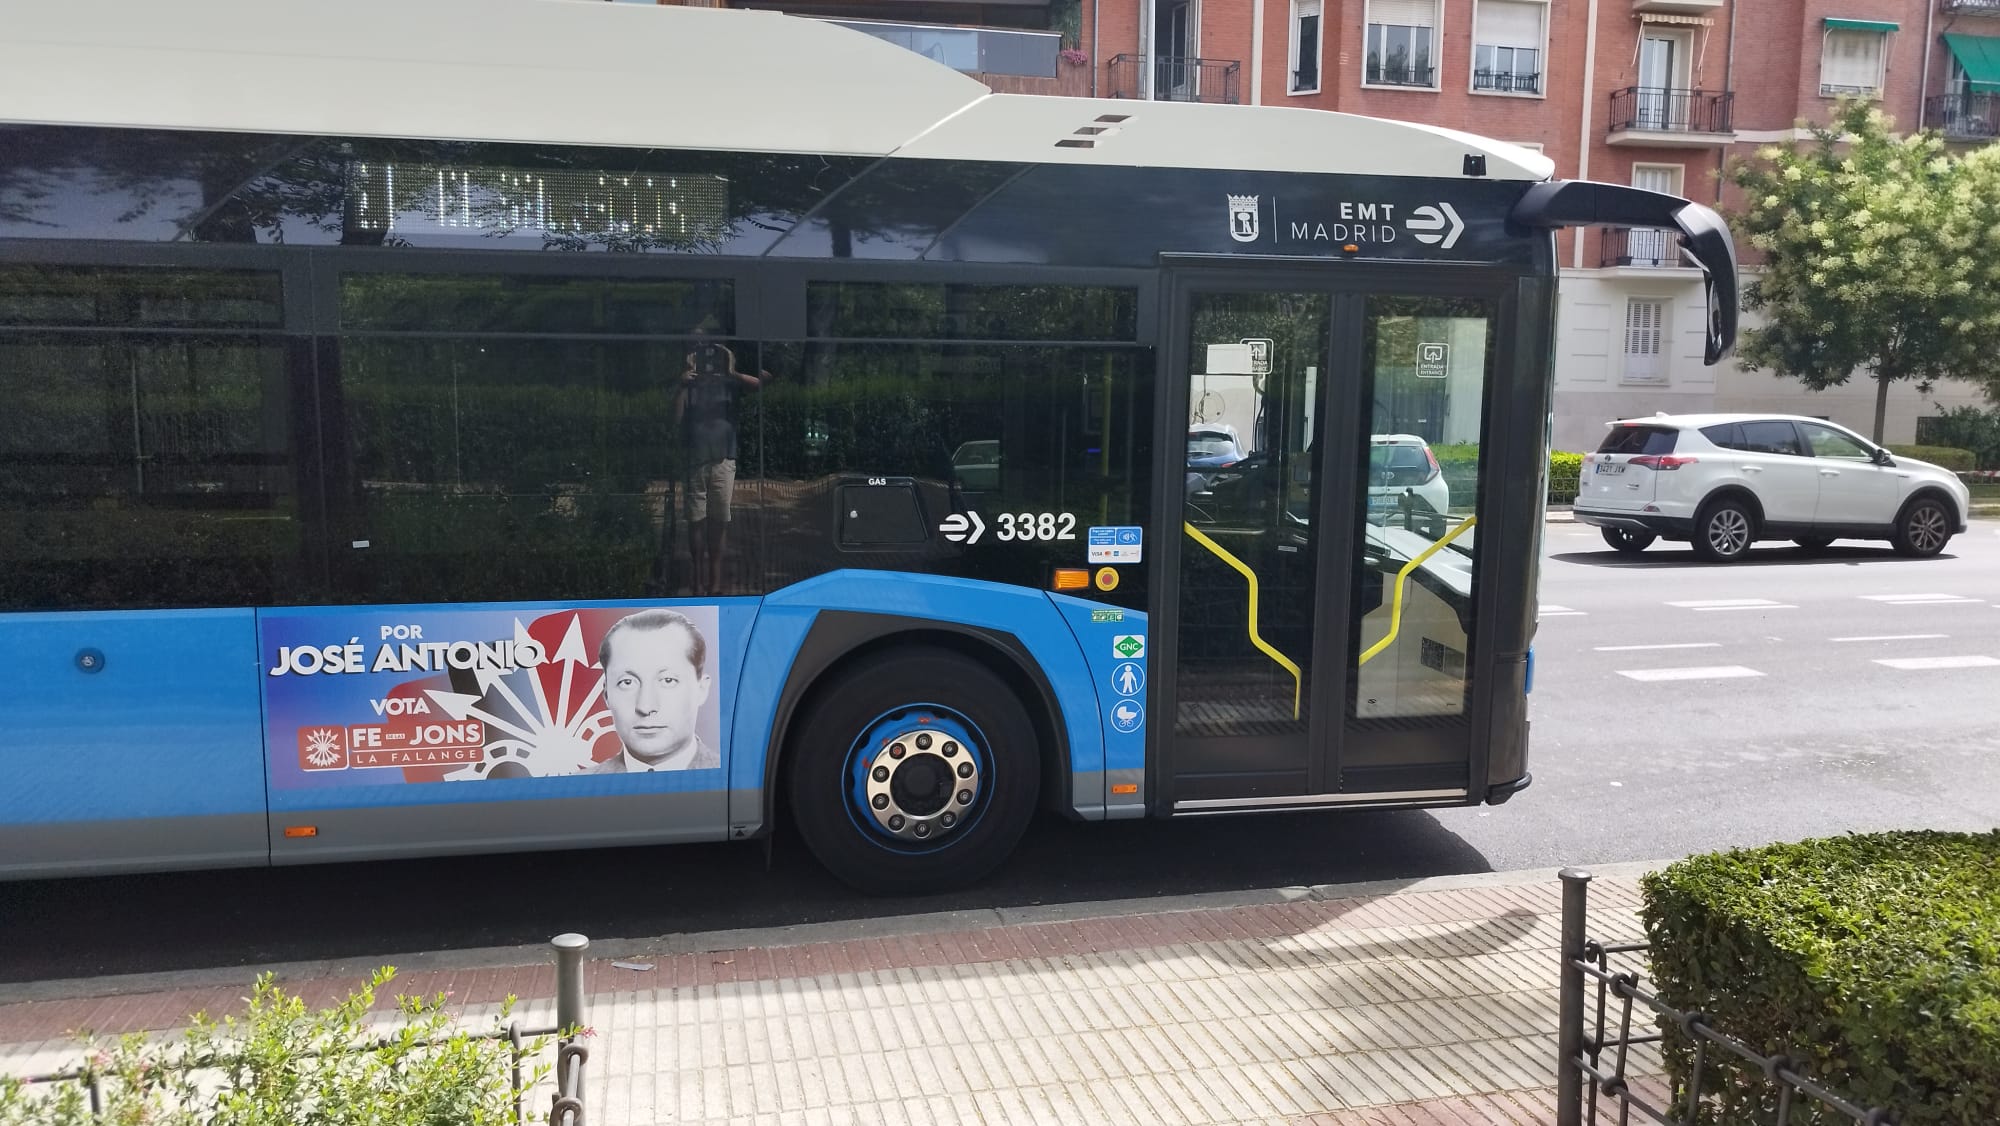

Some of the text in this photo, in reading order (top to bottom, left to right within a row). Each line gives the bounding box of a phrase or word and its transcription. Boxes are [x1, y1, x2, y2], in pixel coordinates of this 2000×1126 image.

[1340, 202, 1395, 221] EMT
[1291, 222, 1396, 243] MADRID
[868, 478, 887, 486] GAS
[996, 512, 1076, 541] 3382
[381, 624, 423, 640] POR
[1119, 642, 1139, 651] GNC
[269, 637, 544, 676] JOSÉ ANTONIO
[370, 697, 431, 716] VOTA
[353, 727, 382, 748] FE
[409, 723, 481, 746] JONS
[357, 750, 477, 764] LA FALANGE
